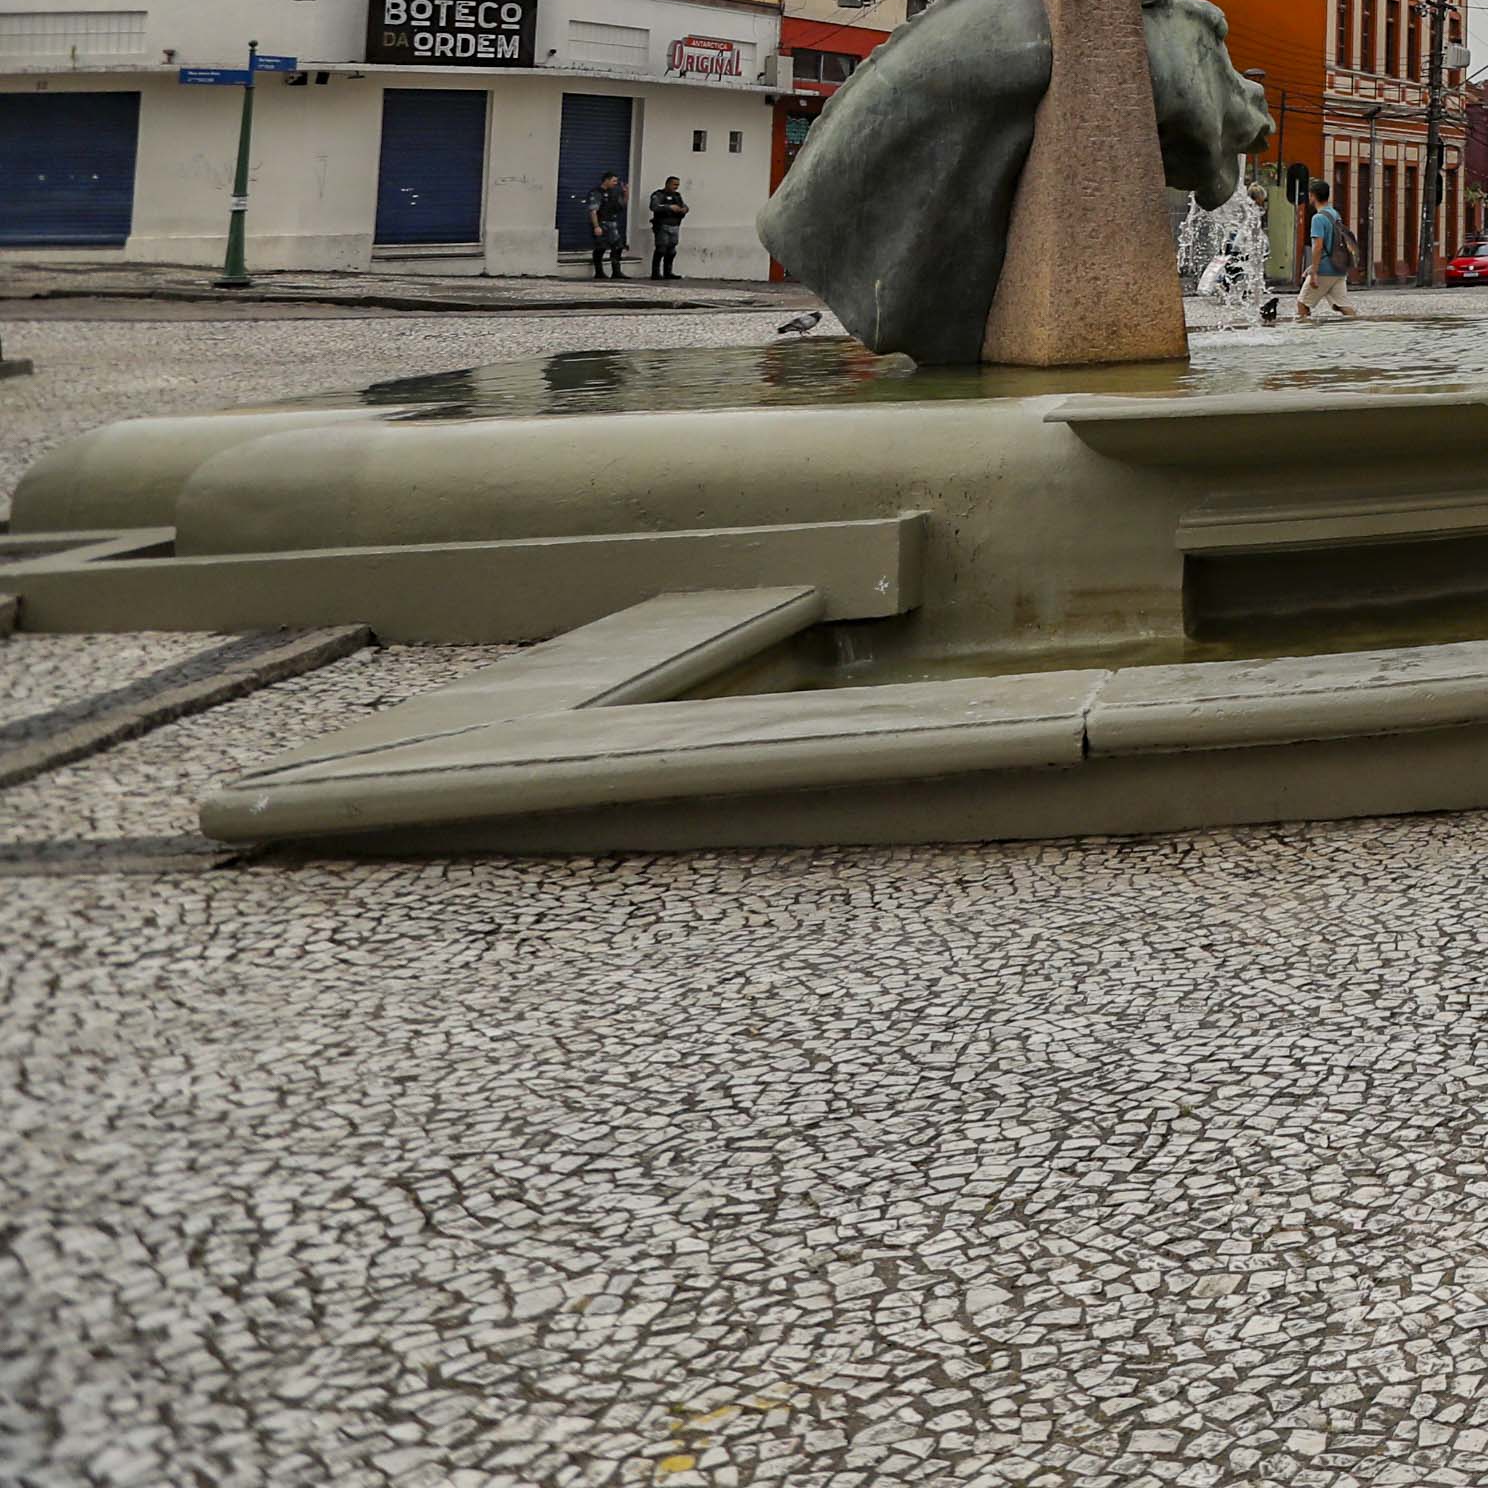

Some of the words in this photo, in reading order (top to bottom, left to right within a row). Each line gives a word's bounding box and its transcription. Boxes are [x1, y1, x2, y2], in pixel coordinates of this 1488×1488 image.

[383, 31, 409, 47] DA
[413, 32, 520, 59] ORDEM
[691, 39, 729, 50] ANTARCTICA
